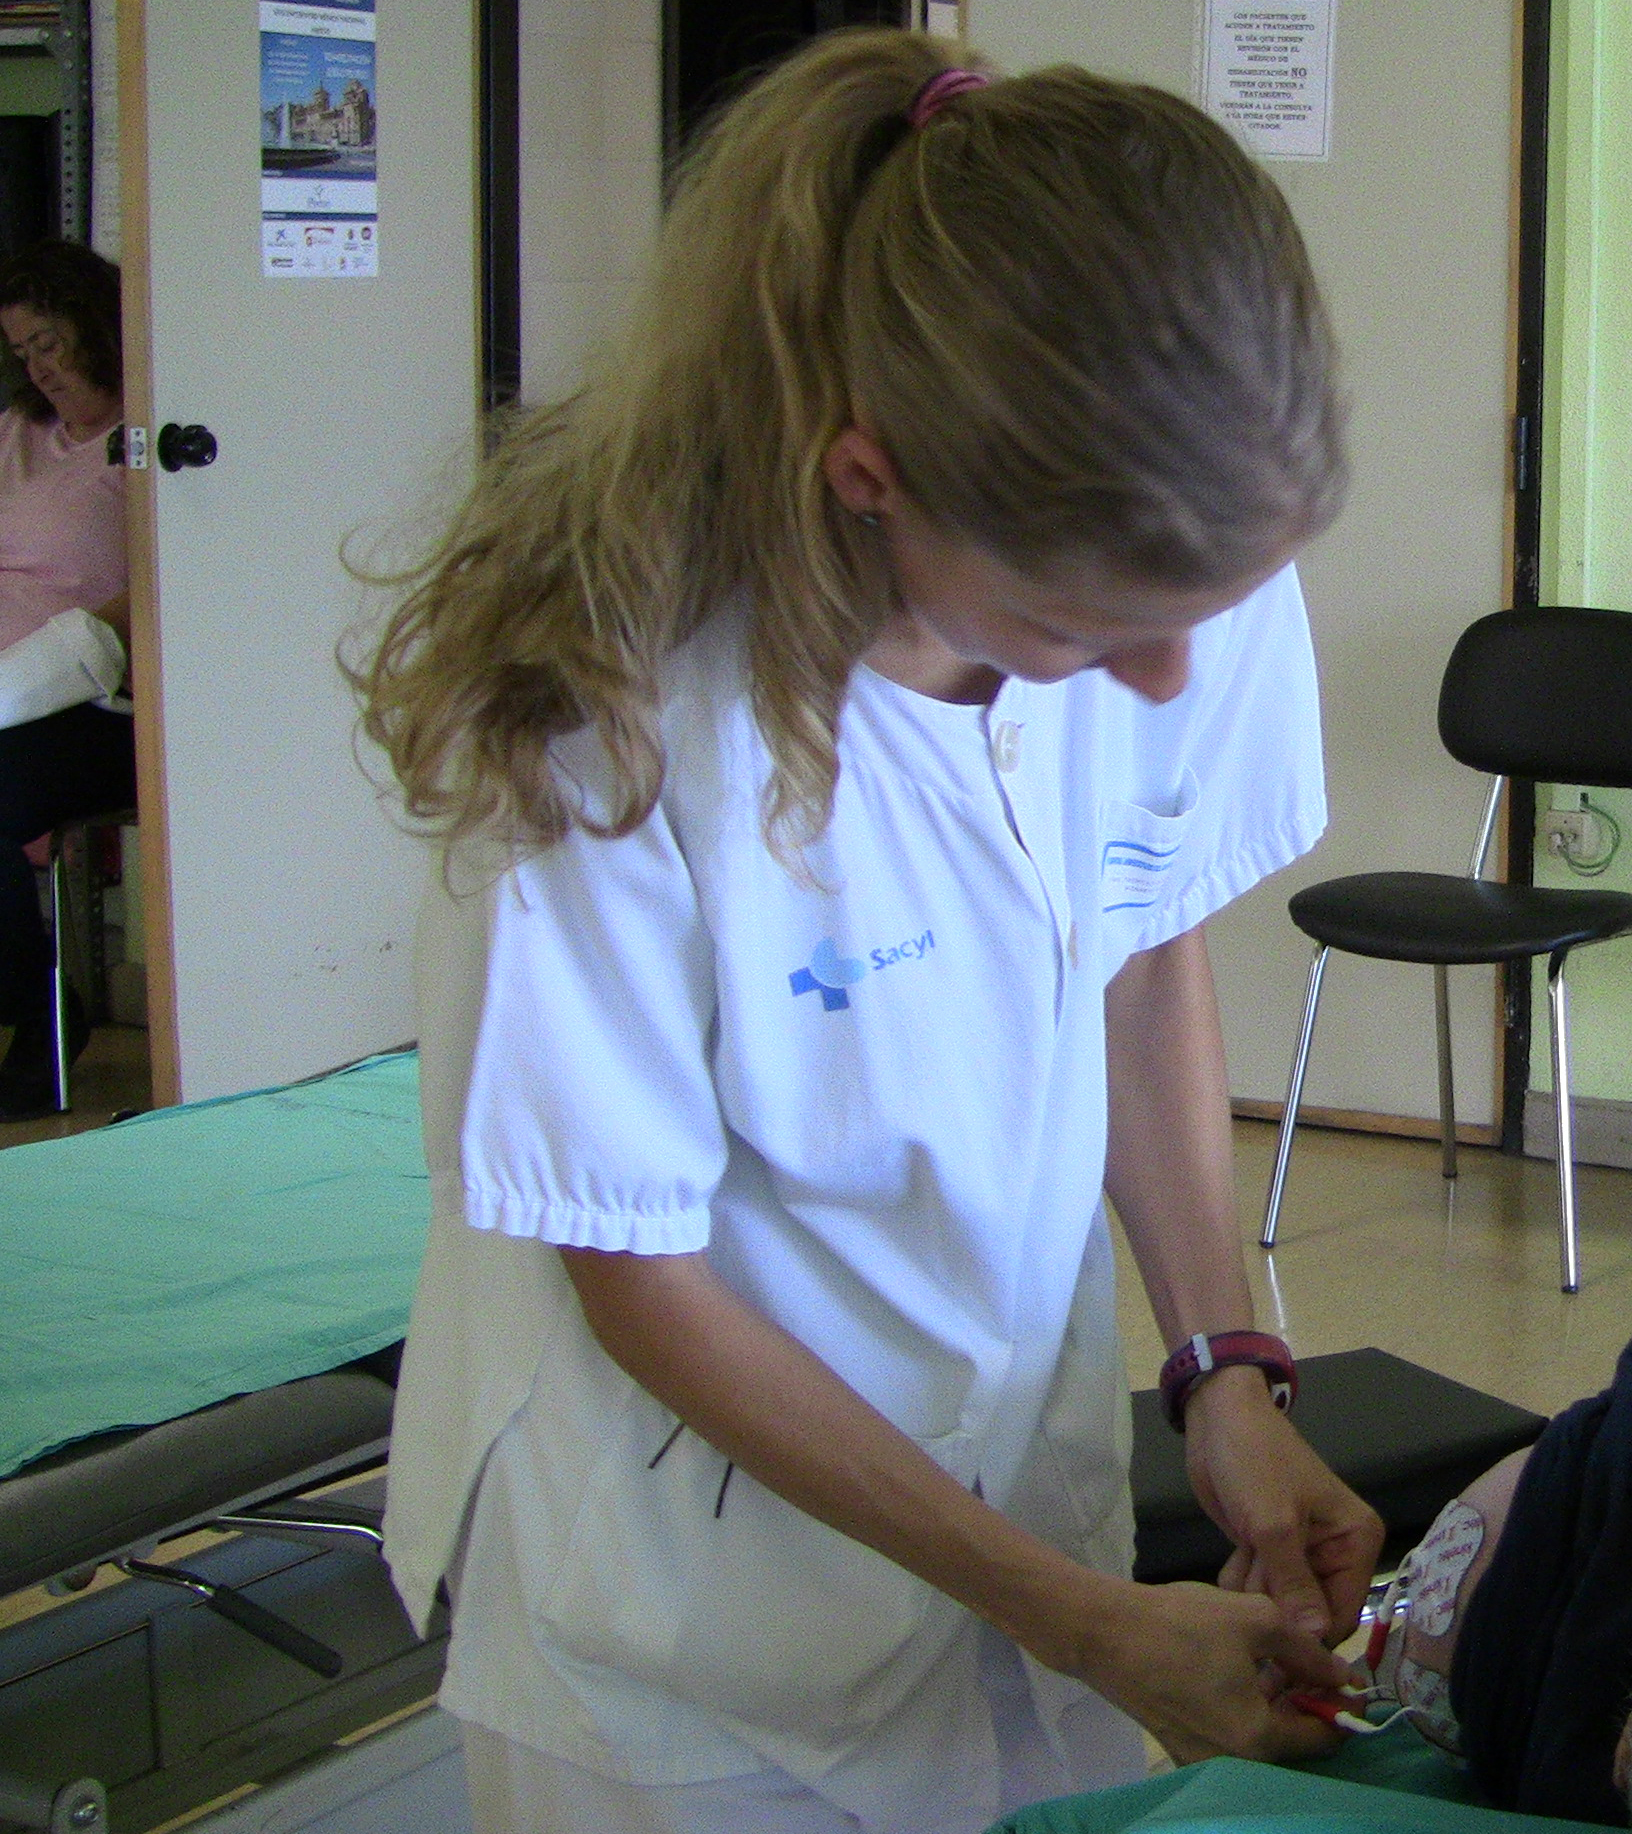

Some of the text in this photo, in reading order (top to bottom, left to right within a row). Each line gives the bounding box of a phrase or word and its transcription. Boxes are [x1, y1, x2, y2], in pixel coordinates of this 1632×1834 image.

[1291, 67, 1307, 79] NO
[1258, 81, 1272, 89] QUE
[869, 929, 935, 971] Sacyl
